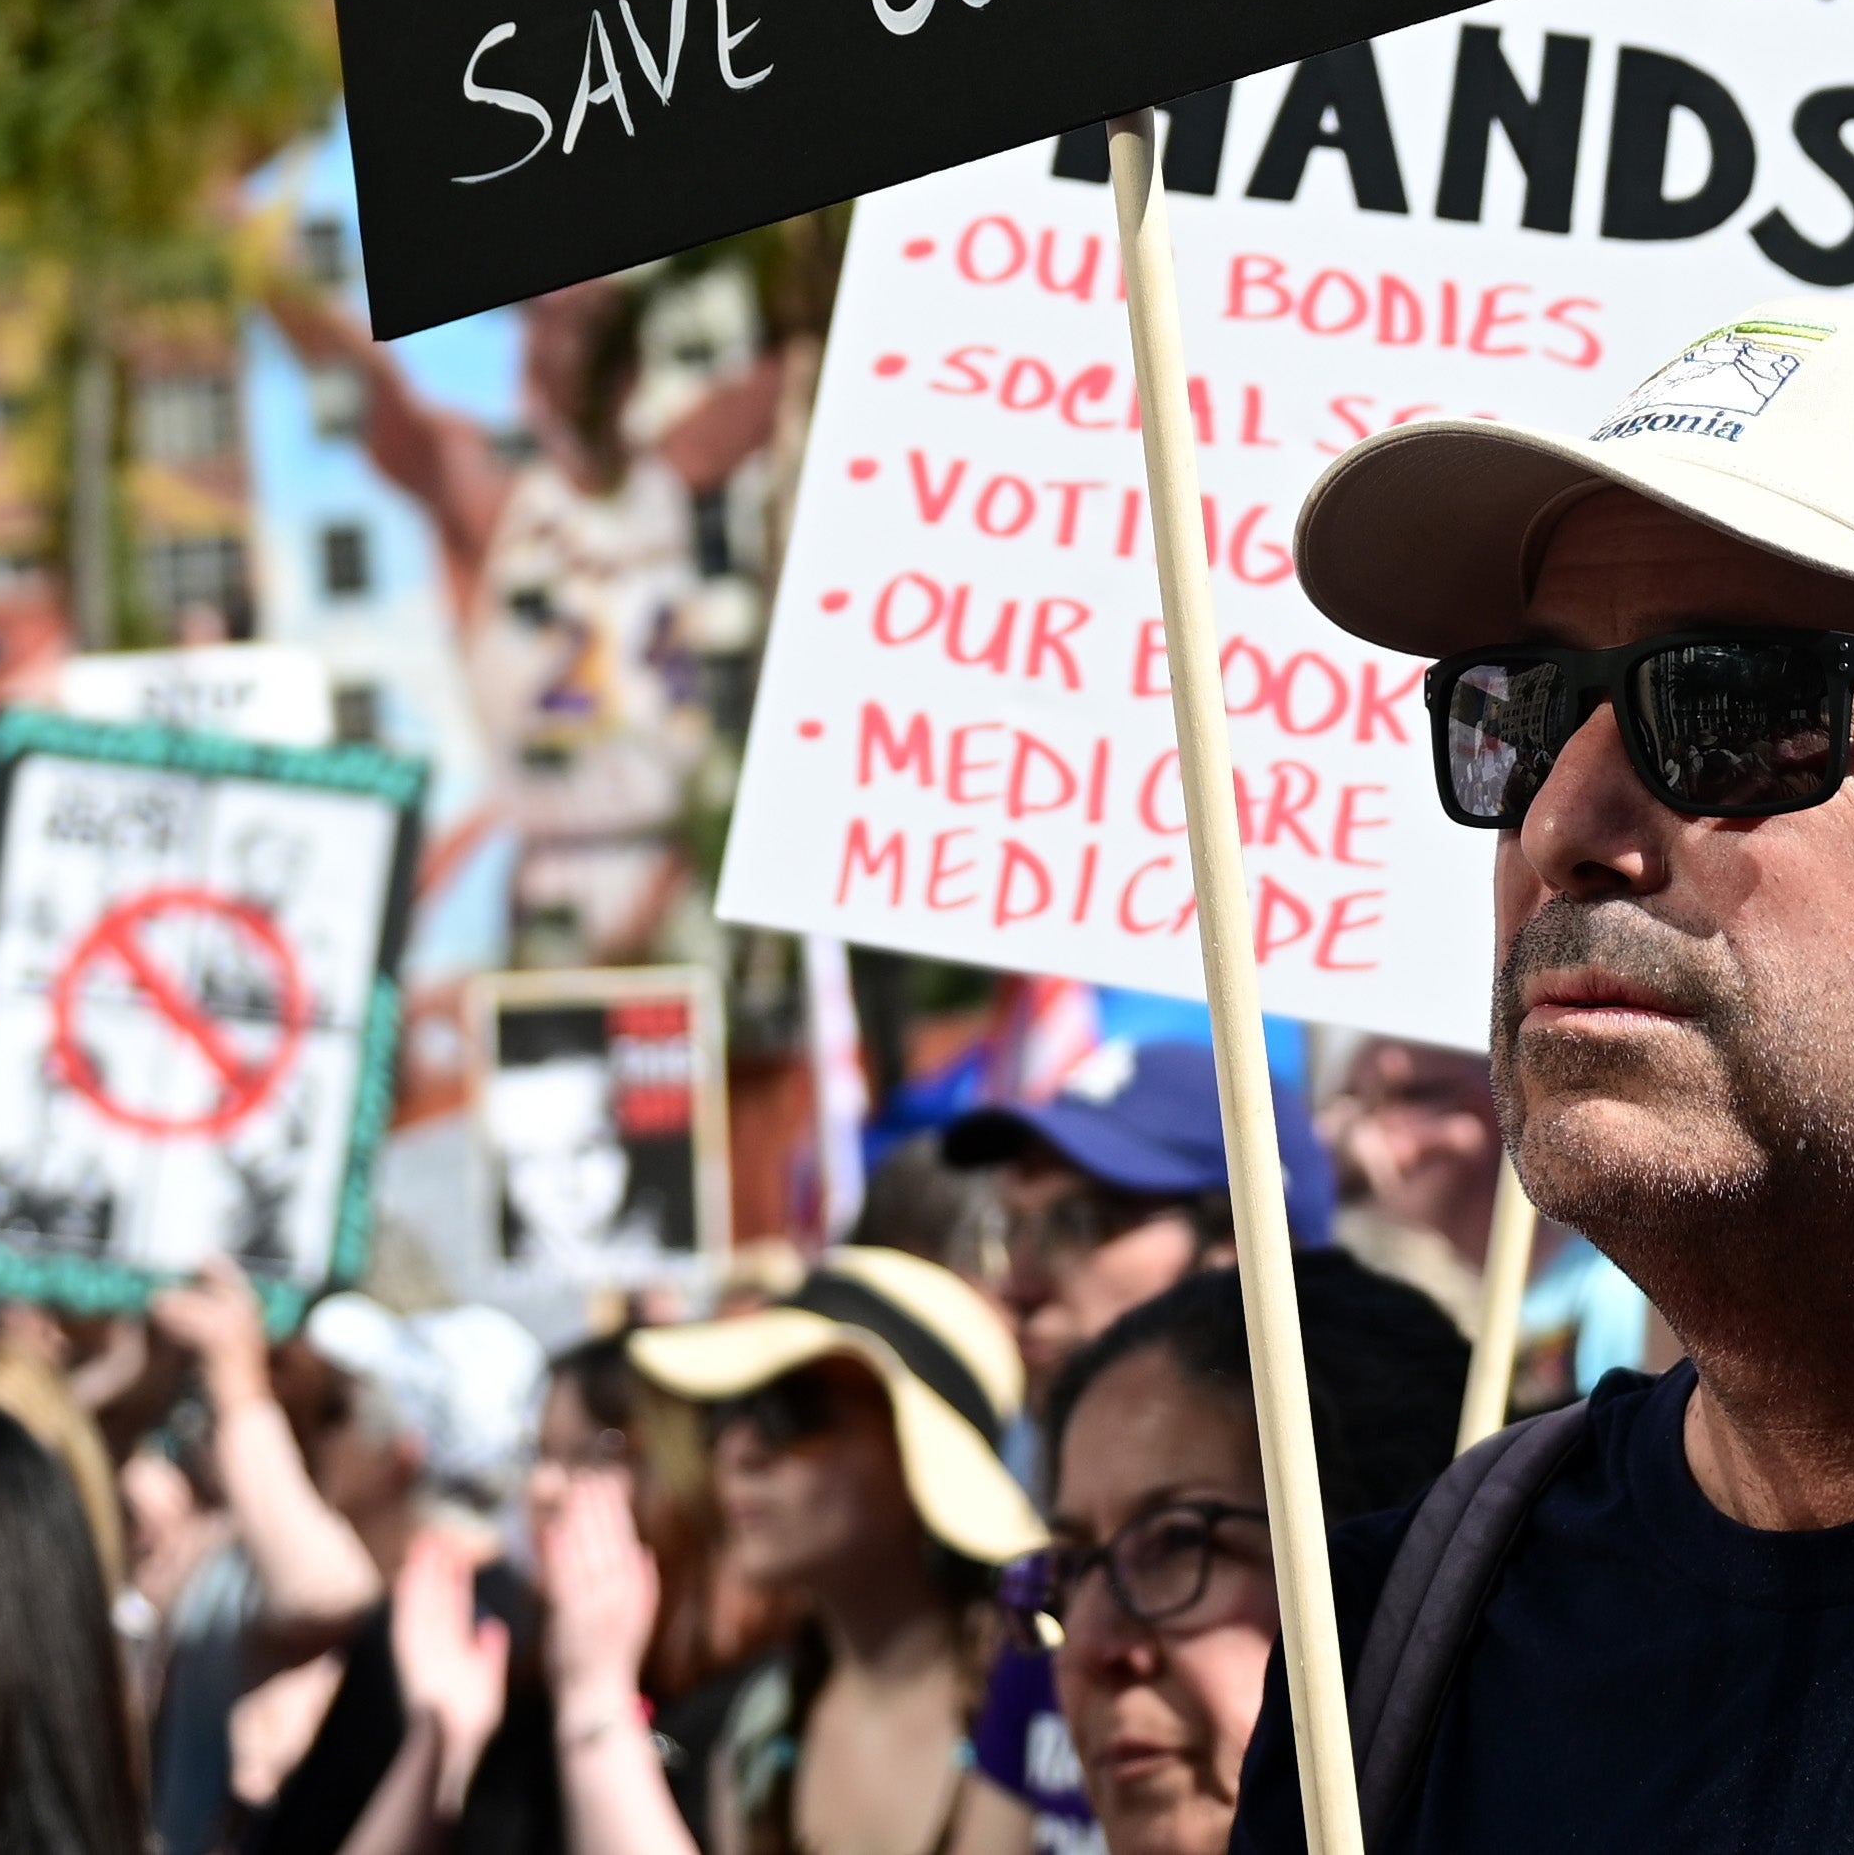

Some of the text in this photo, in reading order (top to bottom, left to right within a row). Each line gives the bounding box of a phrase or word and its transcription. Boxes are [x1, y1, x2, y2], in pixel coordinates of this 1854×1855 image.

[954, 213, 1605, 370] OU BODIES
[870, 570, 1094, 693] OUR
[835, 817, 1387, 973] MEDICDE
